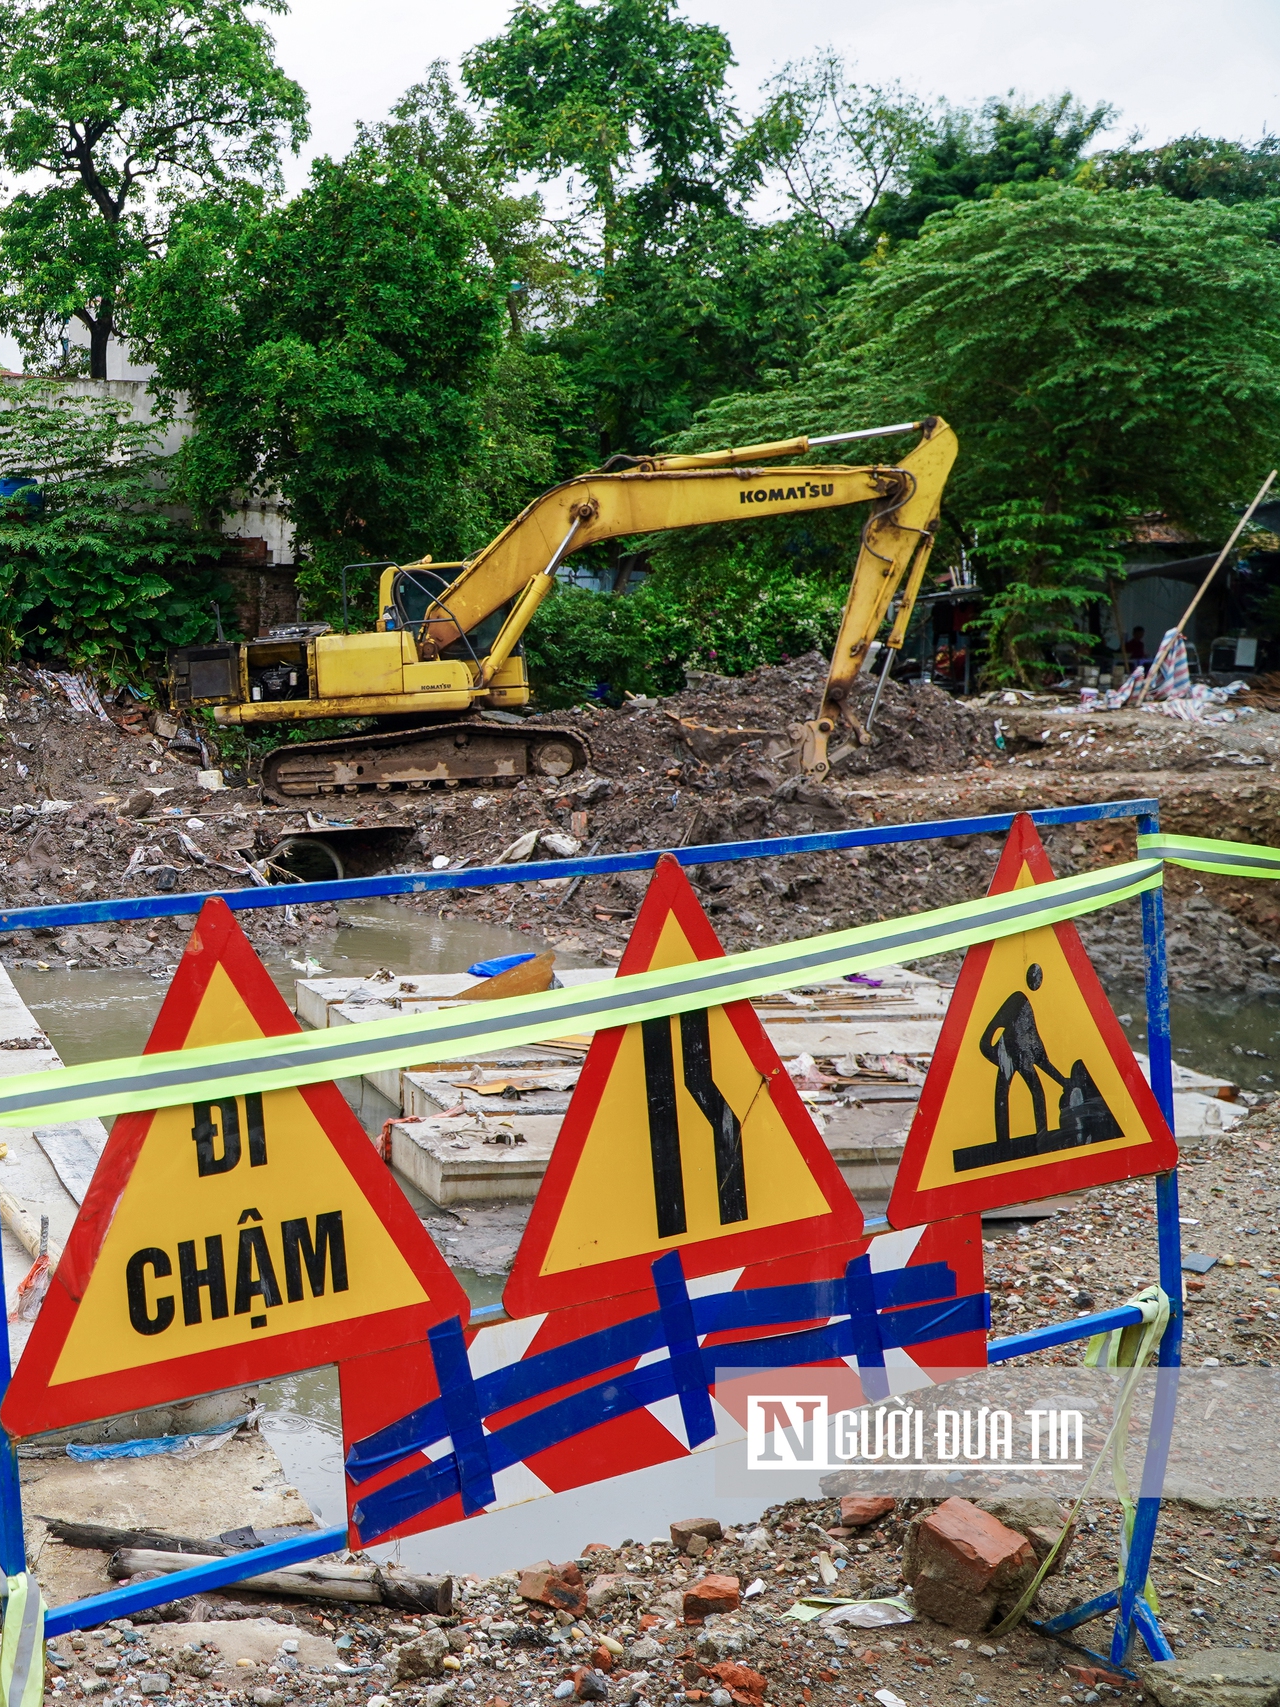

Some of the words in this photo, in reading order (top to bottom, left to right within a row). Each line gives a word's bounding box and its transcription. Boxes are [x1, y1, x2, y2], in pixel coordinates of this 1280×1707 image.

[739, 481, 835, 504] KOMATSU
[420, 683, 452, 691] KOMATSU
[191, 1091, 268, 1178] ĐI
[125, 1207, 349, 1336] CHẬM
